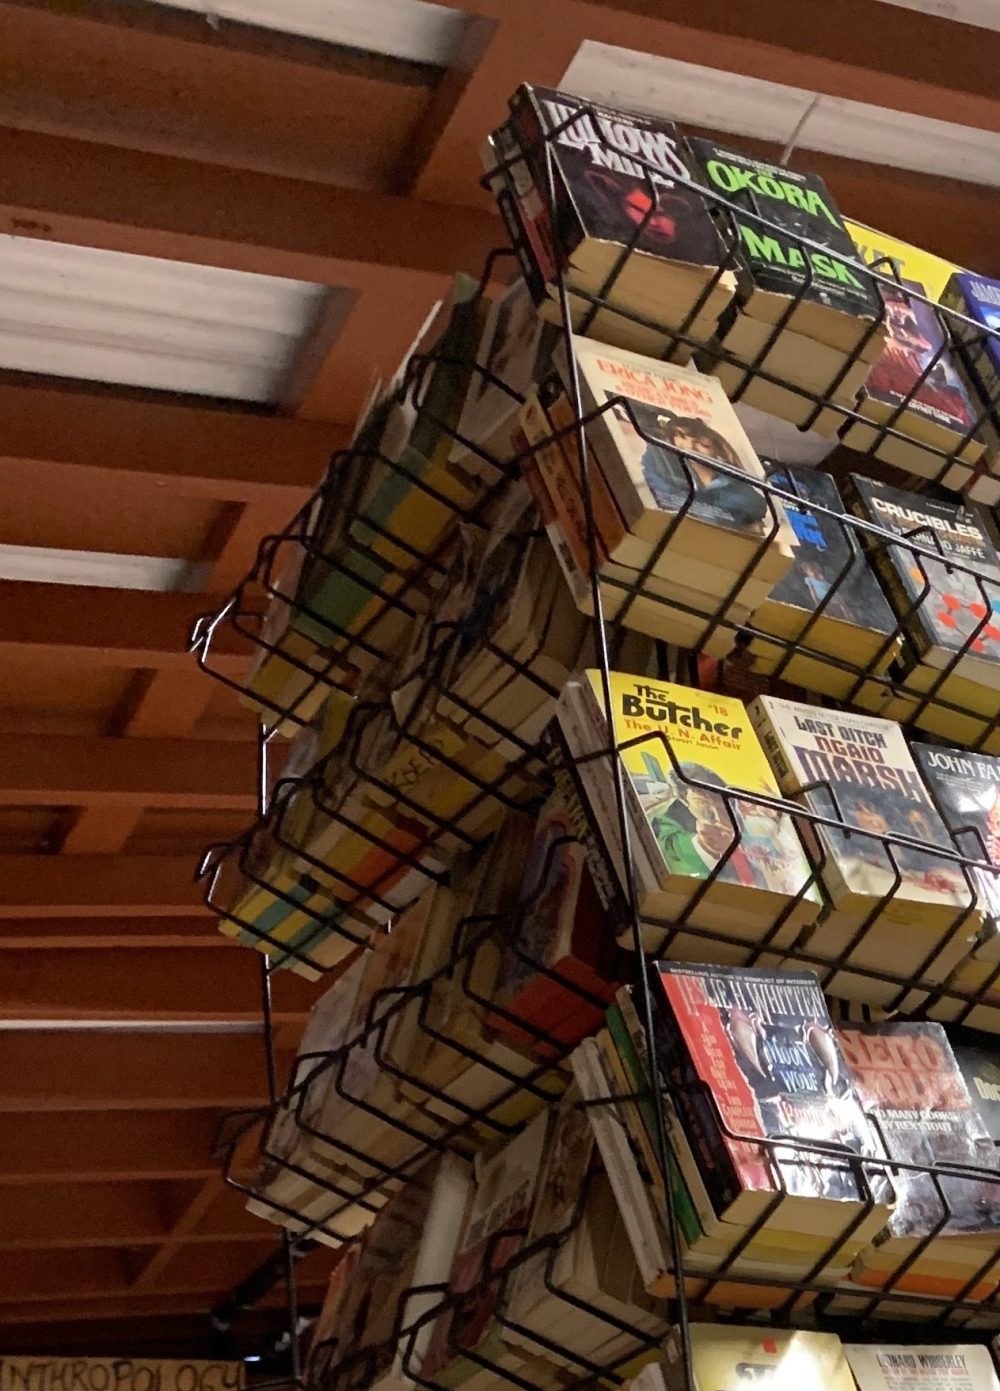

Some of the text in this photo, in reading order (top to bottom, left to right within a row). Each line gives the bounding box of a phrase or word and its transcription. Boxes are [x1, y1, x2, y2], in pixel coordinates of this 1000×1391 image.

[706, 160, 843, 230] OKORA
[738, 223, 867, 291] MASK
[871, 497, 984, 541] CRUCIBLES
[633, 684, 669, 702] The
[622, 693, 743, 740] Butcher
[623, 718, 650, 733] The
[700, 733, 743, 751] Affair
[793, 716, 835, 739] LAST
[838, 725, 889, 749] DITCH
[814, 736, 885, 765] NGAIO
[928, 752, 976, 778] JOHN
[793, 745, 922, 803] MARSH
[749, 982, 827, 1025] WHITTEN
[877, 1354, 916, 1368] LEONARD
